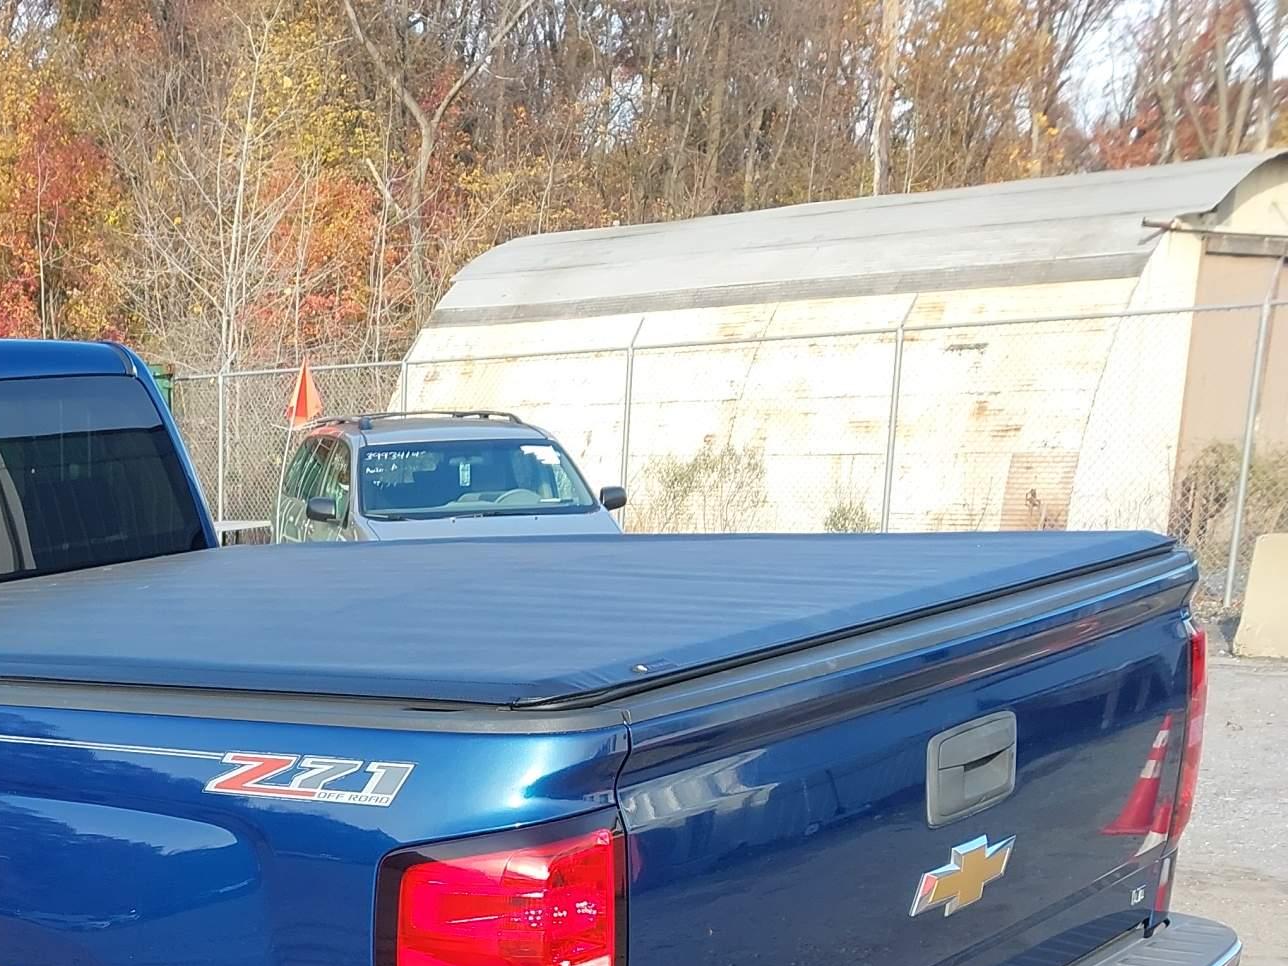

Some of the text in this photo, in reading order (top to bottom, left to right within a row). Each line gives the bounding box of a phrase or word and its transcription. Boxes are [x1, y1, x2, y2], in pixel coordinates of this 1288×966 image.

[203, 751, 416, 802] Z71
[317, 791, 390, 804] OFF ROAD
